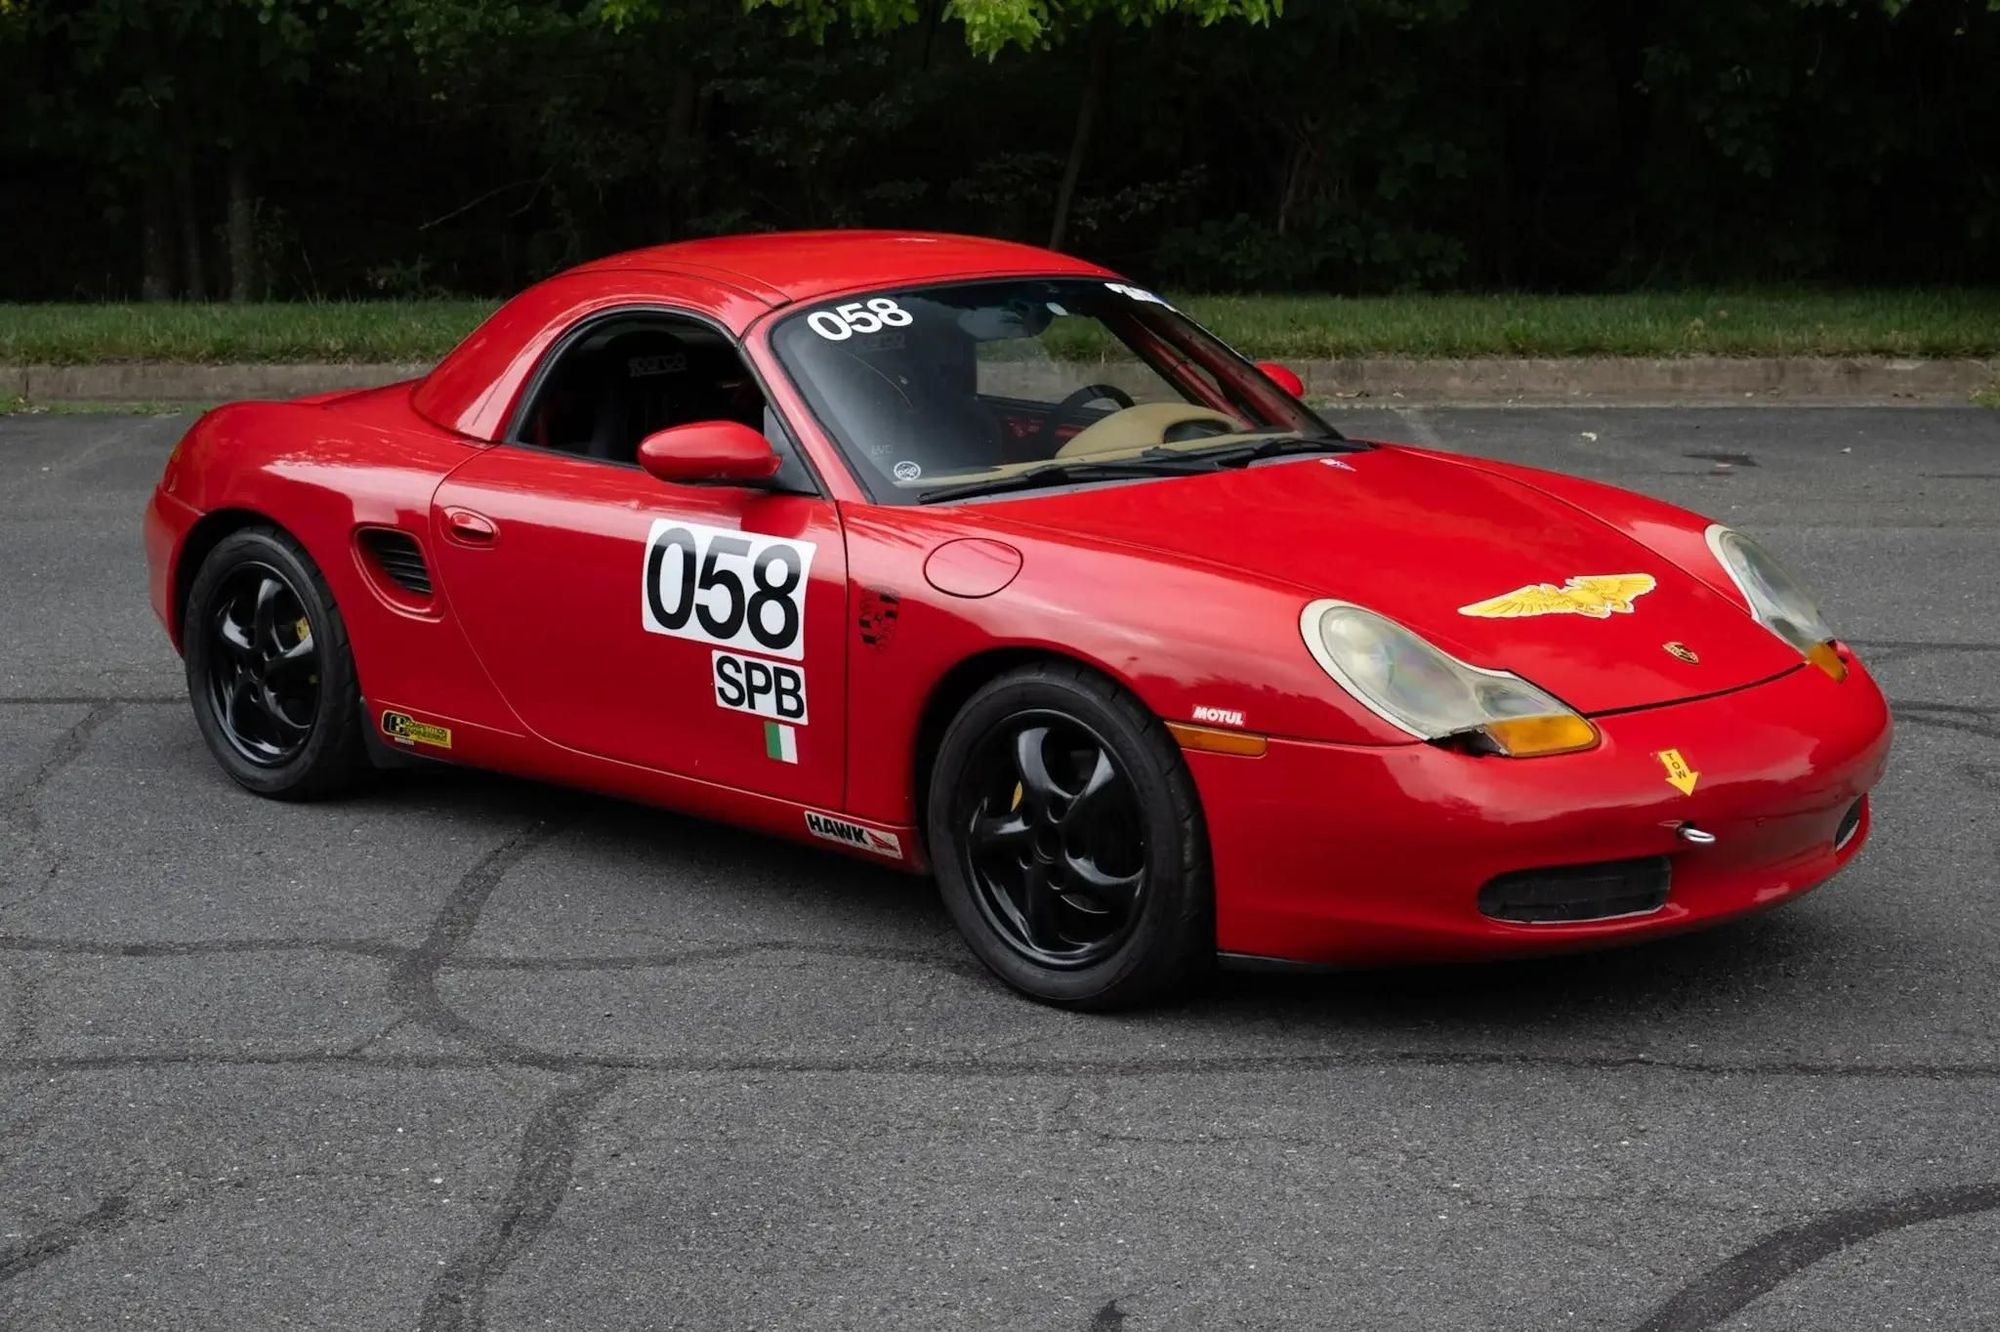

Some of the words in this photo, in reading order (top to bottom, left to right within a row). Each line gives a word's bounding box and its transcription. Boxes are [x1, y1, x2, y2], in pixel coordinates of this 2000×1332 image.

[807, 298, 913, 341] 058
[646, 527, 801, 650] 058
[716, 655, 805, 719] SPB
[1192, 706, 1244, 725] MOTUL
[1665, 752, 1687, 780] TOW
[806, 813, 869, 846] HAWK
